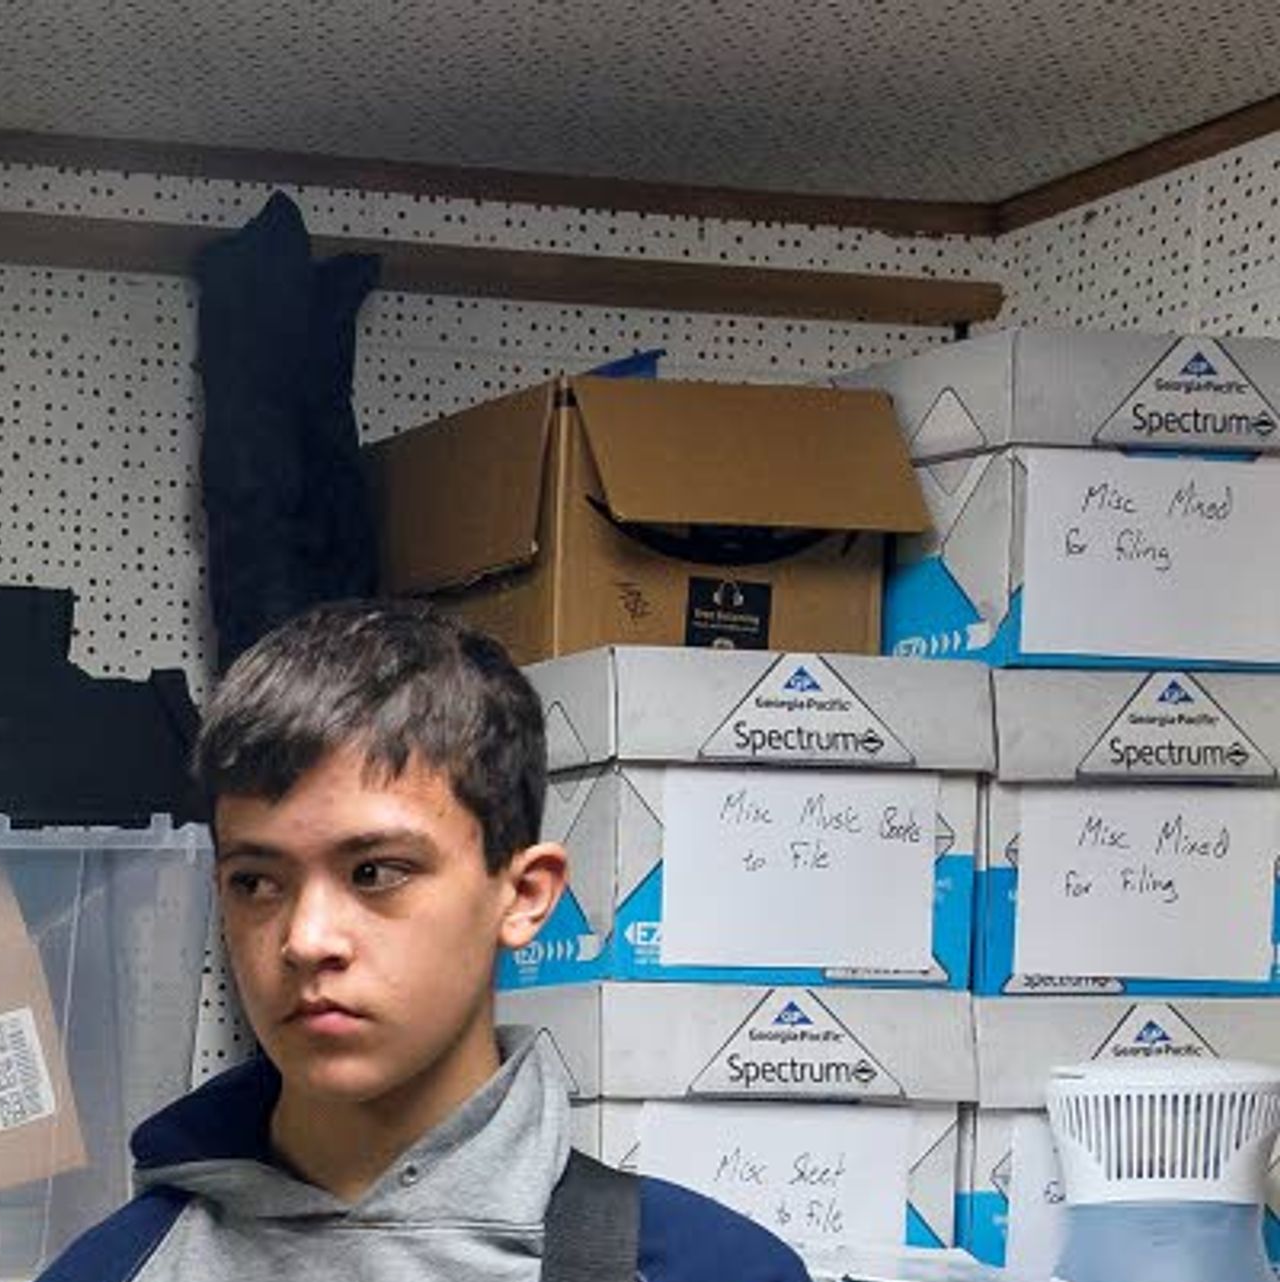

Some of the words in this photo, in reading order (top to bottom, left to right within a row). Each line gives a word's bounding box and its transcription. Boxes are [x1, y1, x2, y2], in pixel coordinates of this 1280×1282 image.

[1132, 403, 1251, 437] Spectrum
[1081, 482, 1137, 513] Misc
[733, 720, 859, 754] Spectrum
[1109, 736, 1227, 769] Spectrum
[719, 789, 773, 824] Misc
[1078, 816, 1130, 849] Misc
[1155, 814, 1230, 858] Mixed
[742, 851, 767, 871] to
[726, 1053, 852, 1088] Spectrum
